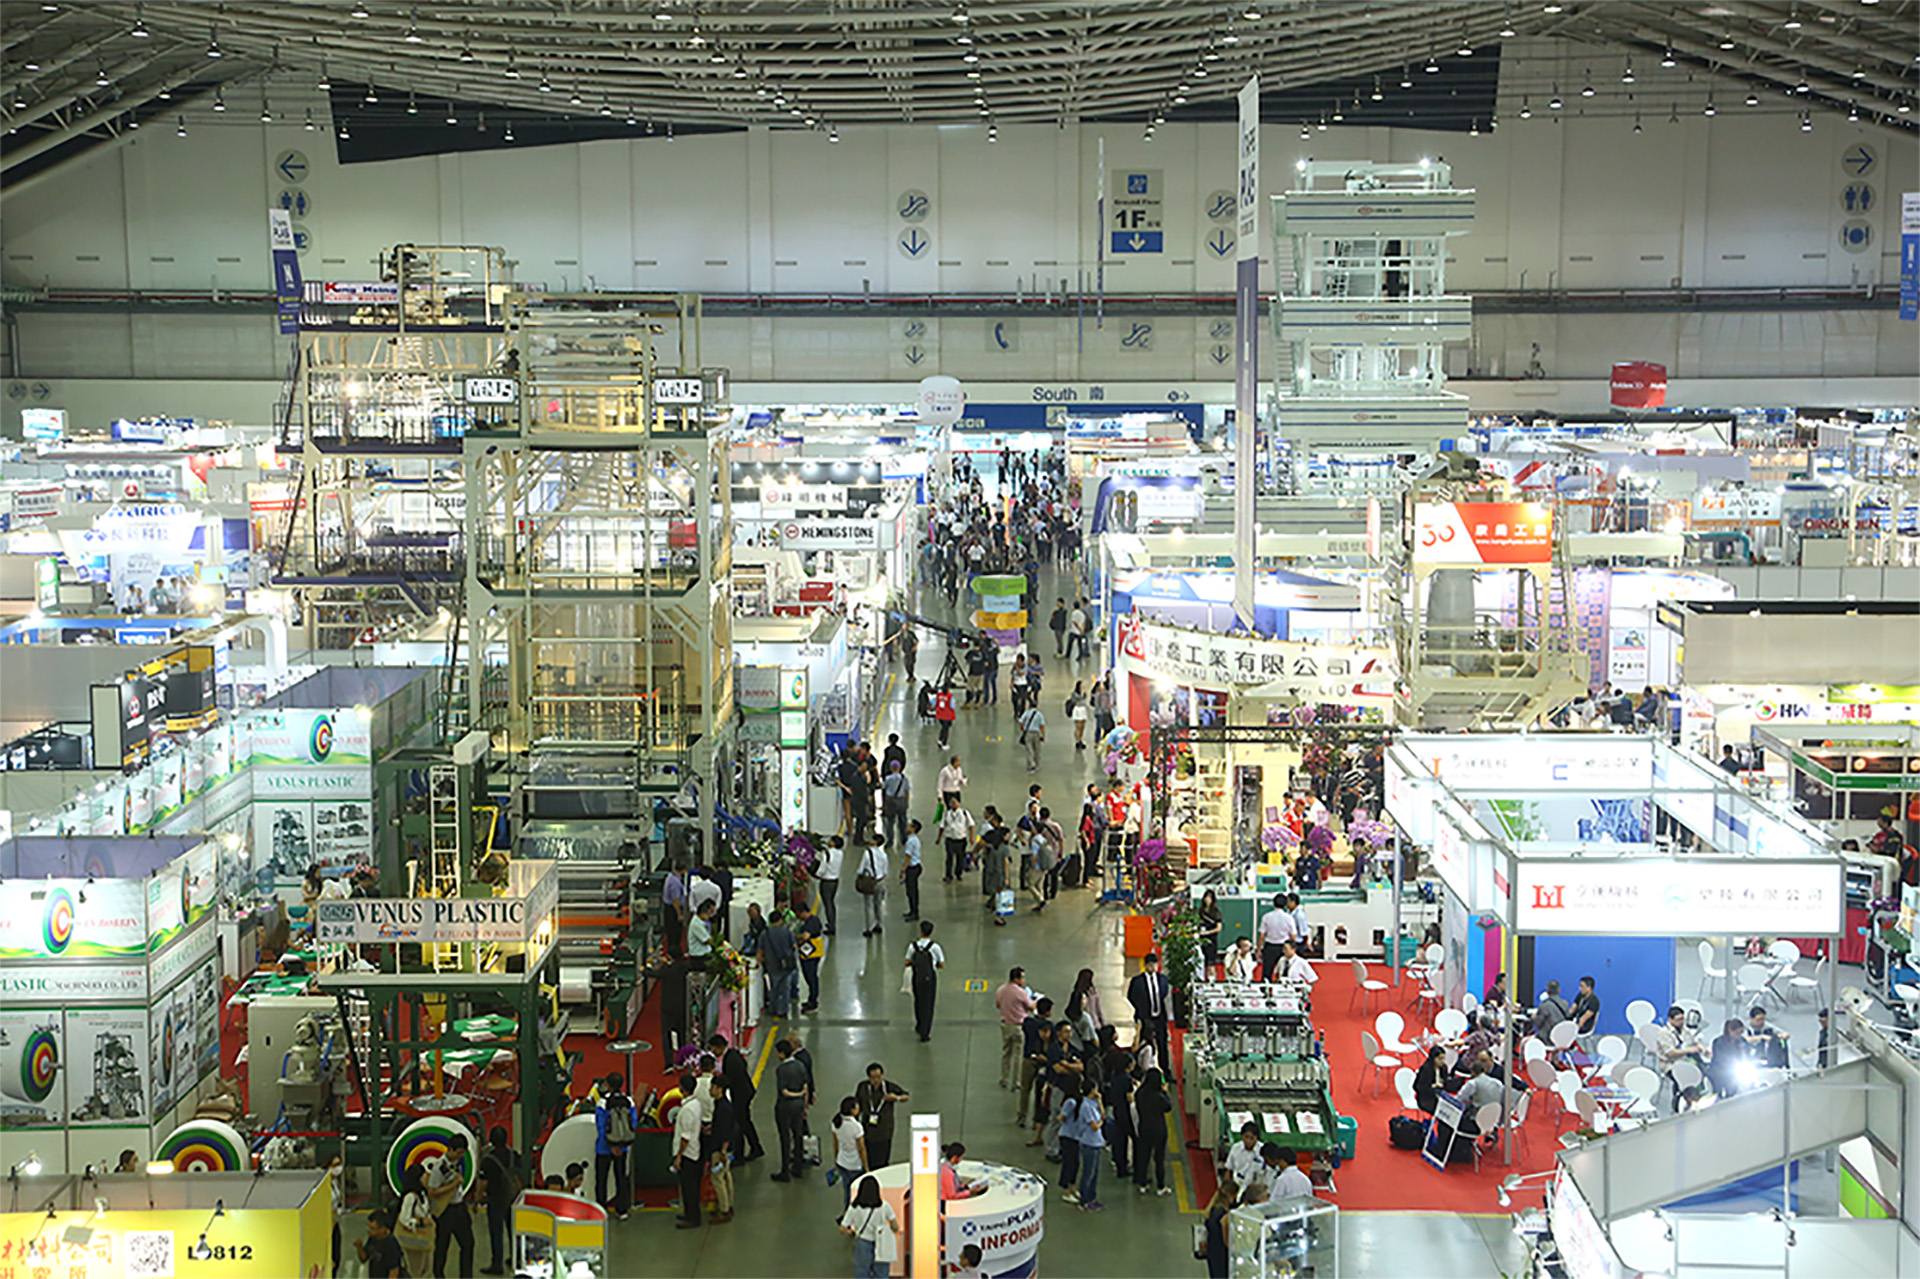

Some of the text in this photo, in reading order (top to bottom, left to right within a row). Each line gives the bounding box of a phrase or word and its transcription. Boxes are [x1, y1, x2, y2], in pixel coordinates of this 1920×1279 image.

[1115, 209, 1146, 229] 1F
[1033, 388, 1077, 402] South
[356, 902, 423, 924] VENUS
[433, 902, 524, 924] PLASTIC
